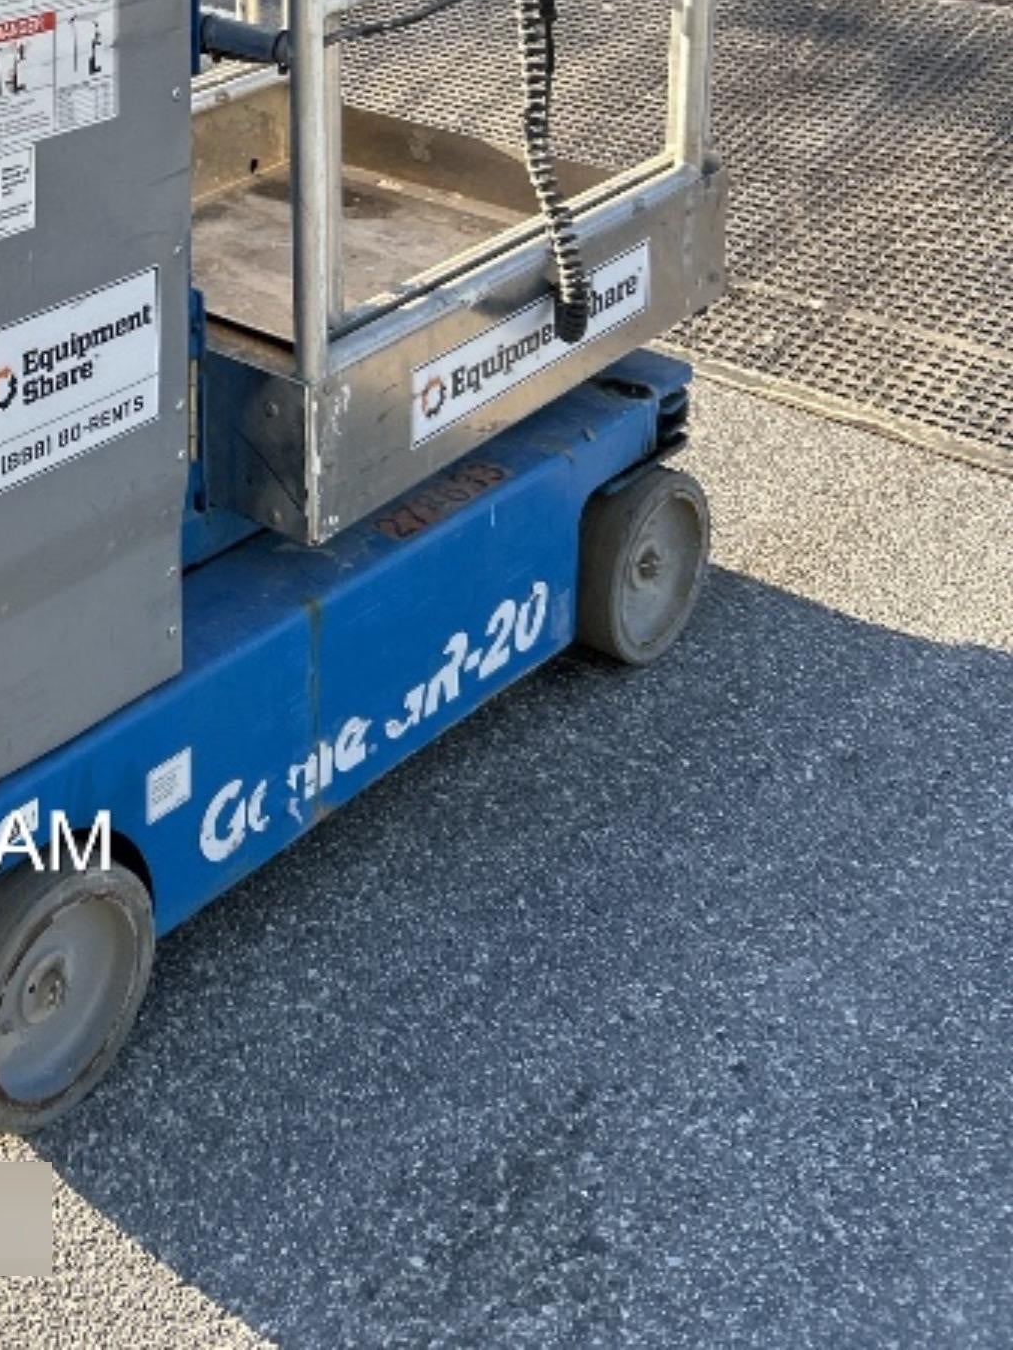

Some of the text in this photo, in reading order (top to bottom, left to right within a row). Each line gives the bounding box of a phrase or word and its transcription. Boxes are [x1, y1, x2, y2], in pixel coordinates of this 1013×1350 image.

[22, 304, 152, 376] Equipment
[450, 274, 639, 399] Equipme hare
[22, 359, 93, 405] Share
